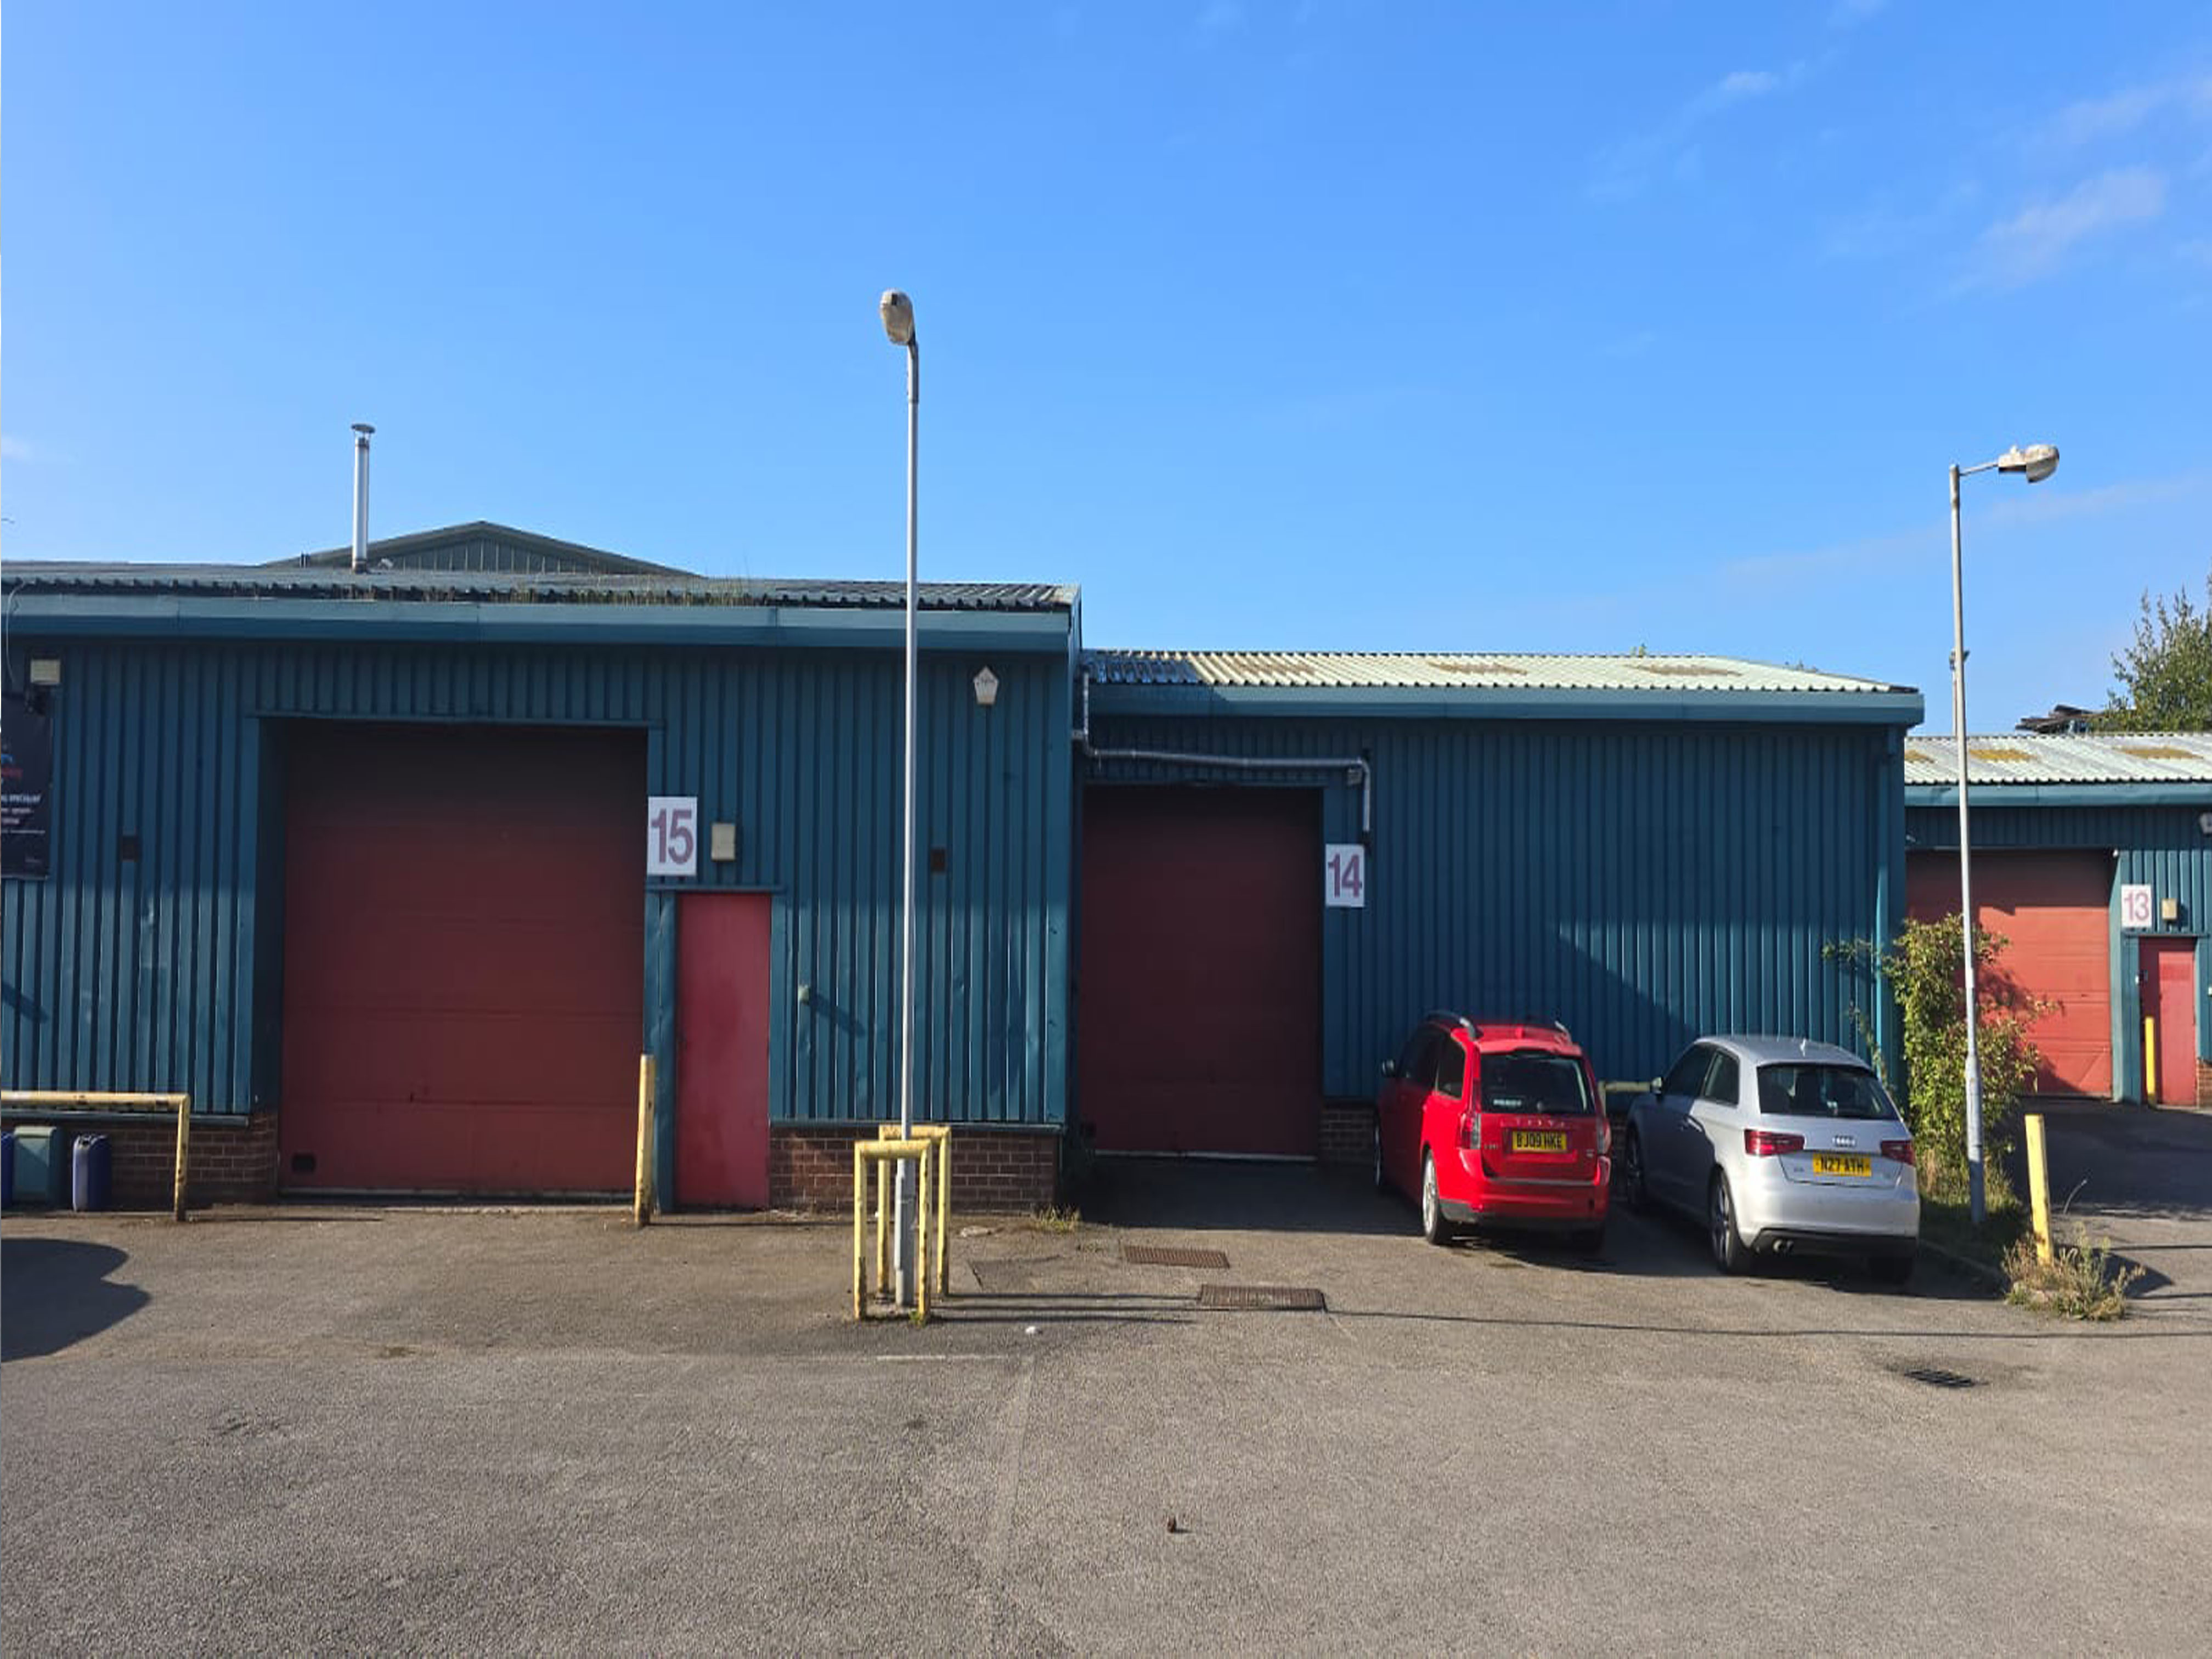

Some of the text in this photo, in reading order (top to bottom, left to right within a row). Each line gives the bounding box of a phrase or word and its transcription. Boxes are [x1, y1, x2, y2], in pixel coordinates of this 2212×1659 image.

[651, 809, 694, 865] 15
[1328, 853, 1363, 898] 14
[2124, 891, 2149, 921] 13
